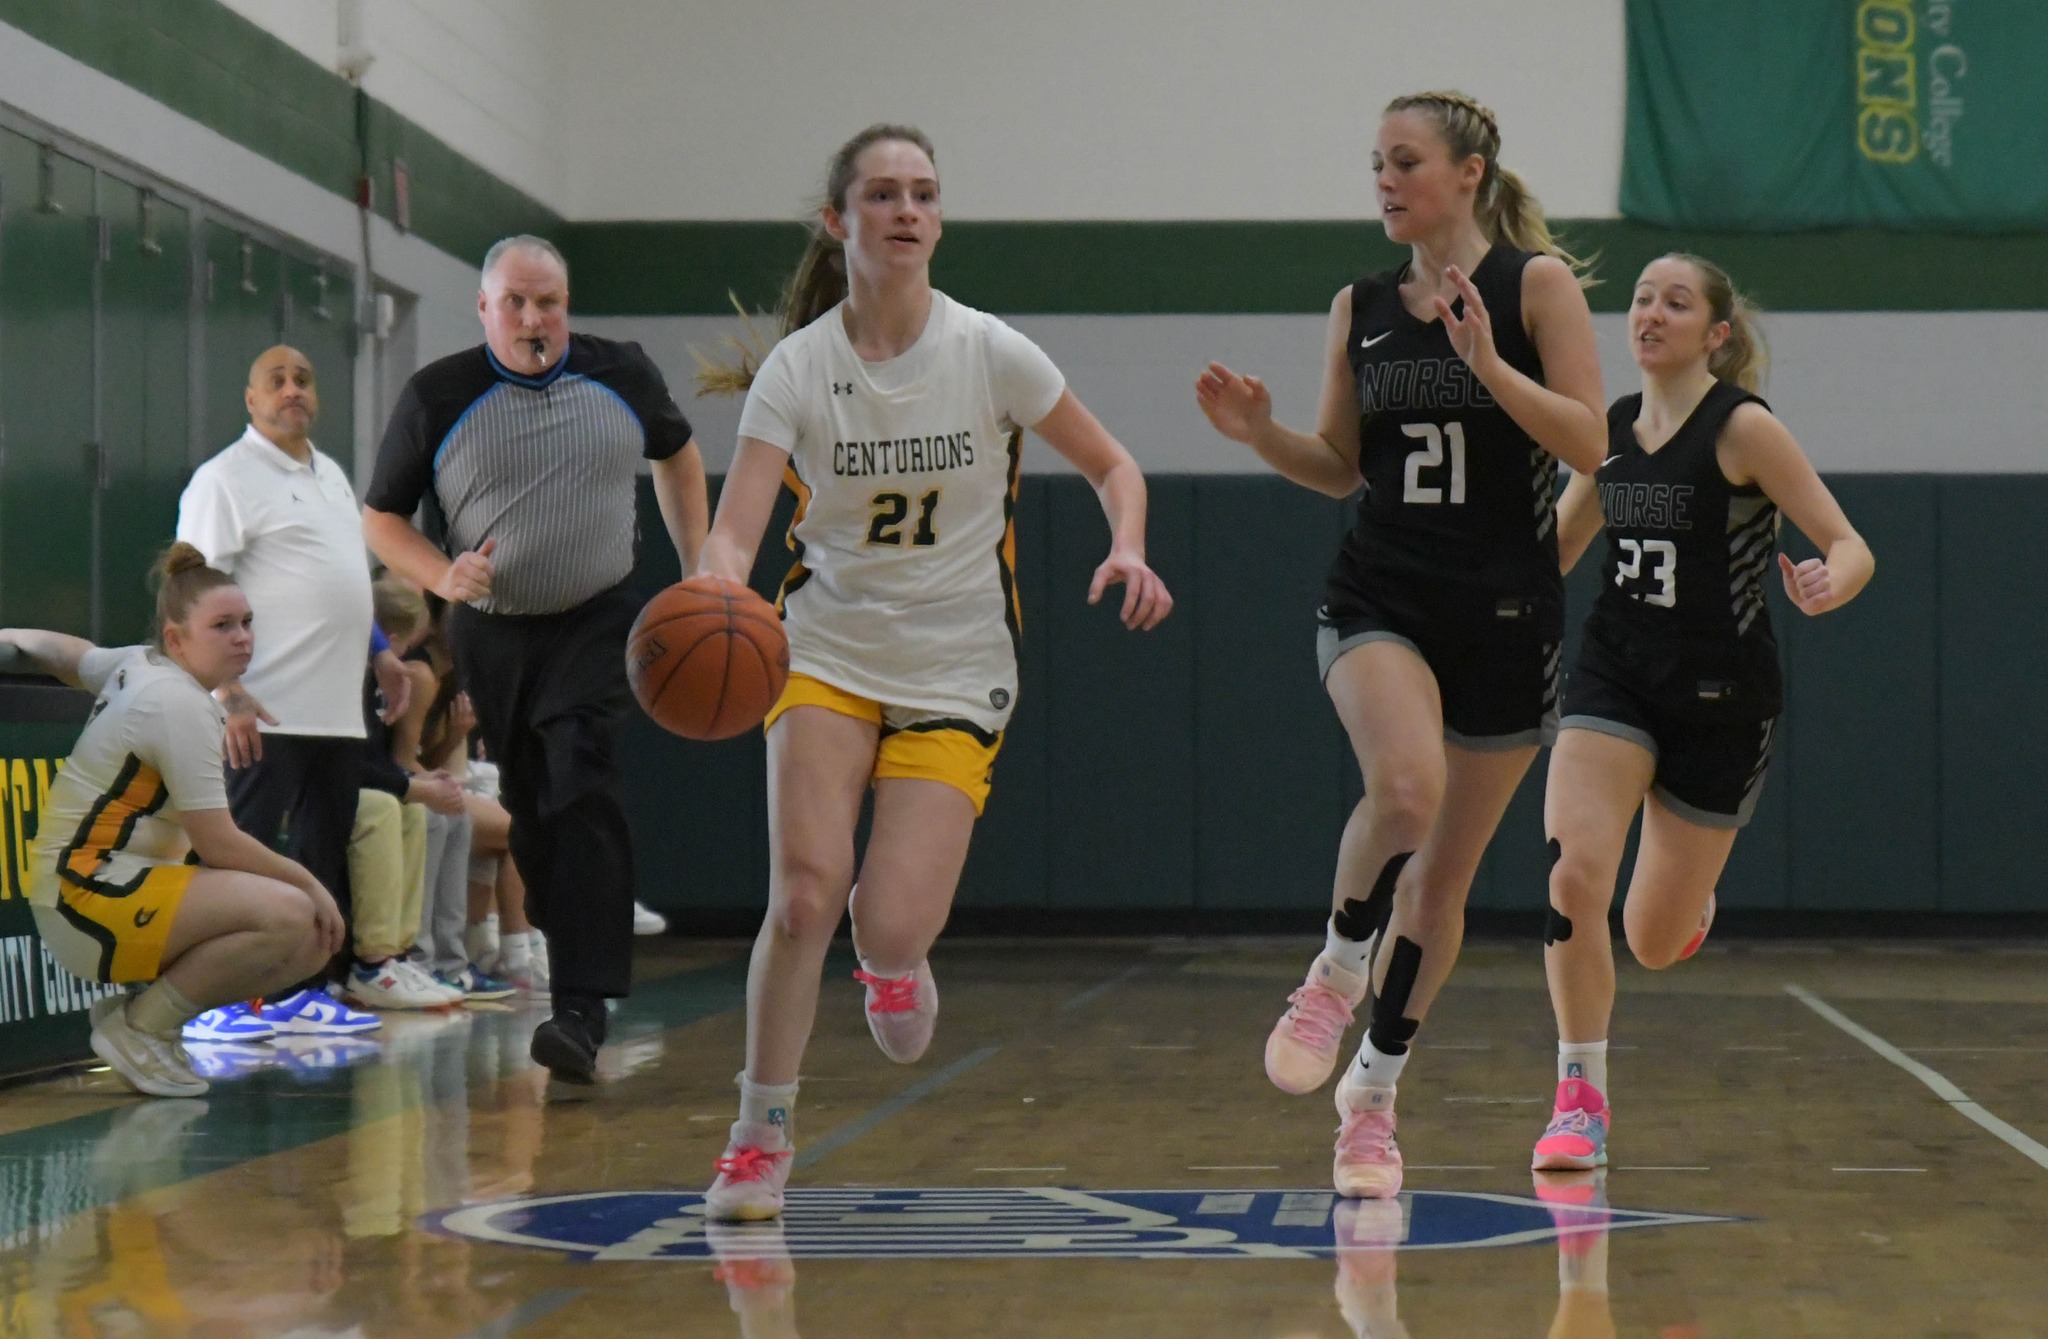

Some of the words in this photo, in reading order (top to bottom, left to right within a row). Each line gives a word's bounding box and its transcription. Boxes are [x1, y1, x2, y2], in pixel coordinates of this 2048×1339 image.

[1922, 44, 1968, 168] College
[833, 431, 975, 477] CENTURIONS
[1400, 421, 1466, 504] 21
[863, 486, 943, 547] 21
[1614, 538, 1678, 608] 23
